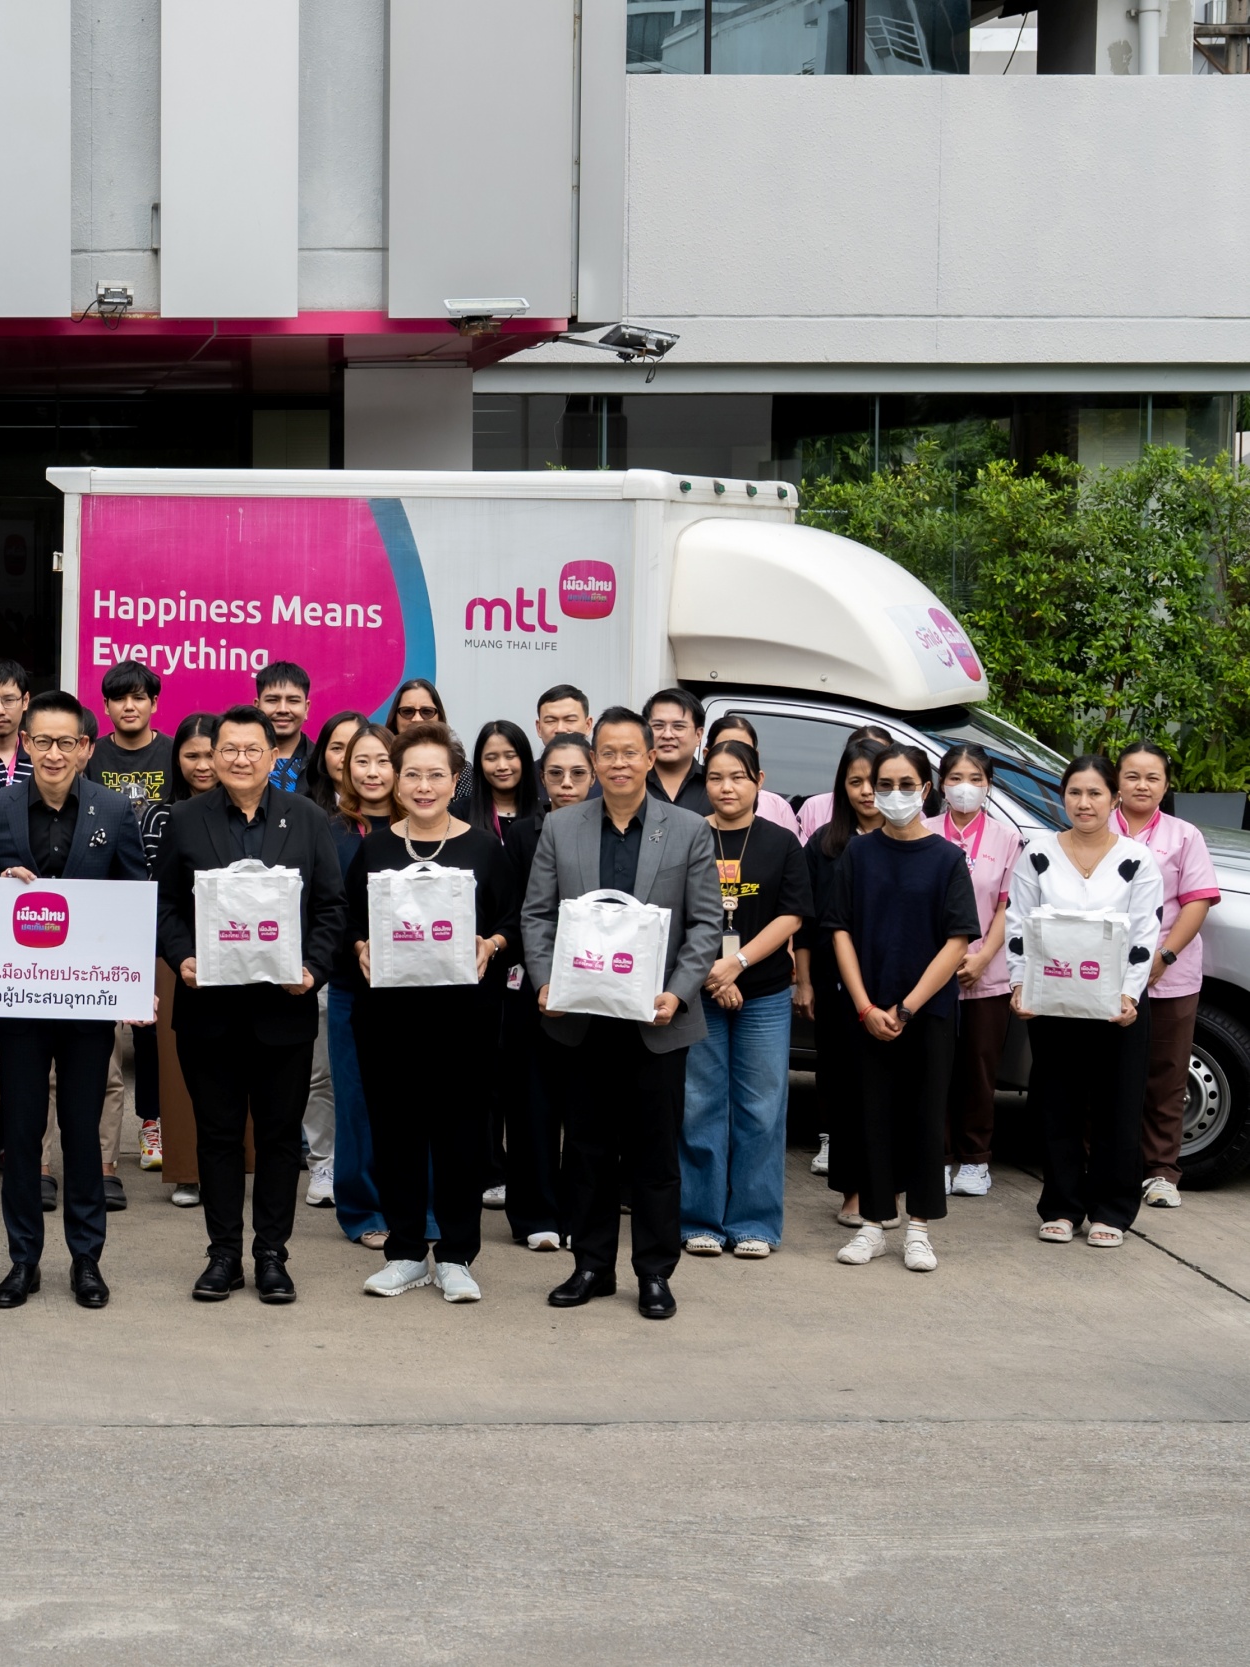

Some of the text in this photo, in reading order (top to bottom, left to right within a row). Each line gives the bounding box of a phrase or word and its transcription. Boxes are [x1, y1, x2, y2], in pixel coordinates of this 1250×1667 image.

[562, 575, 612, 592] เมืองไทย
[93, 589, 383, 628] Happiness Means
[465, 587, 558, 634] mtl
[464, 639, 558, 651] MUANG THAI LIFE
[93, 636, 269, 679] Everything
[102, 771, 164, 786] HOME
[16, 906, 66, 922] เมืองไทย
